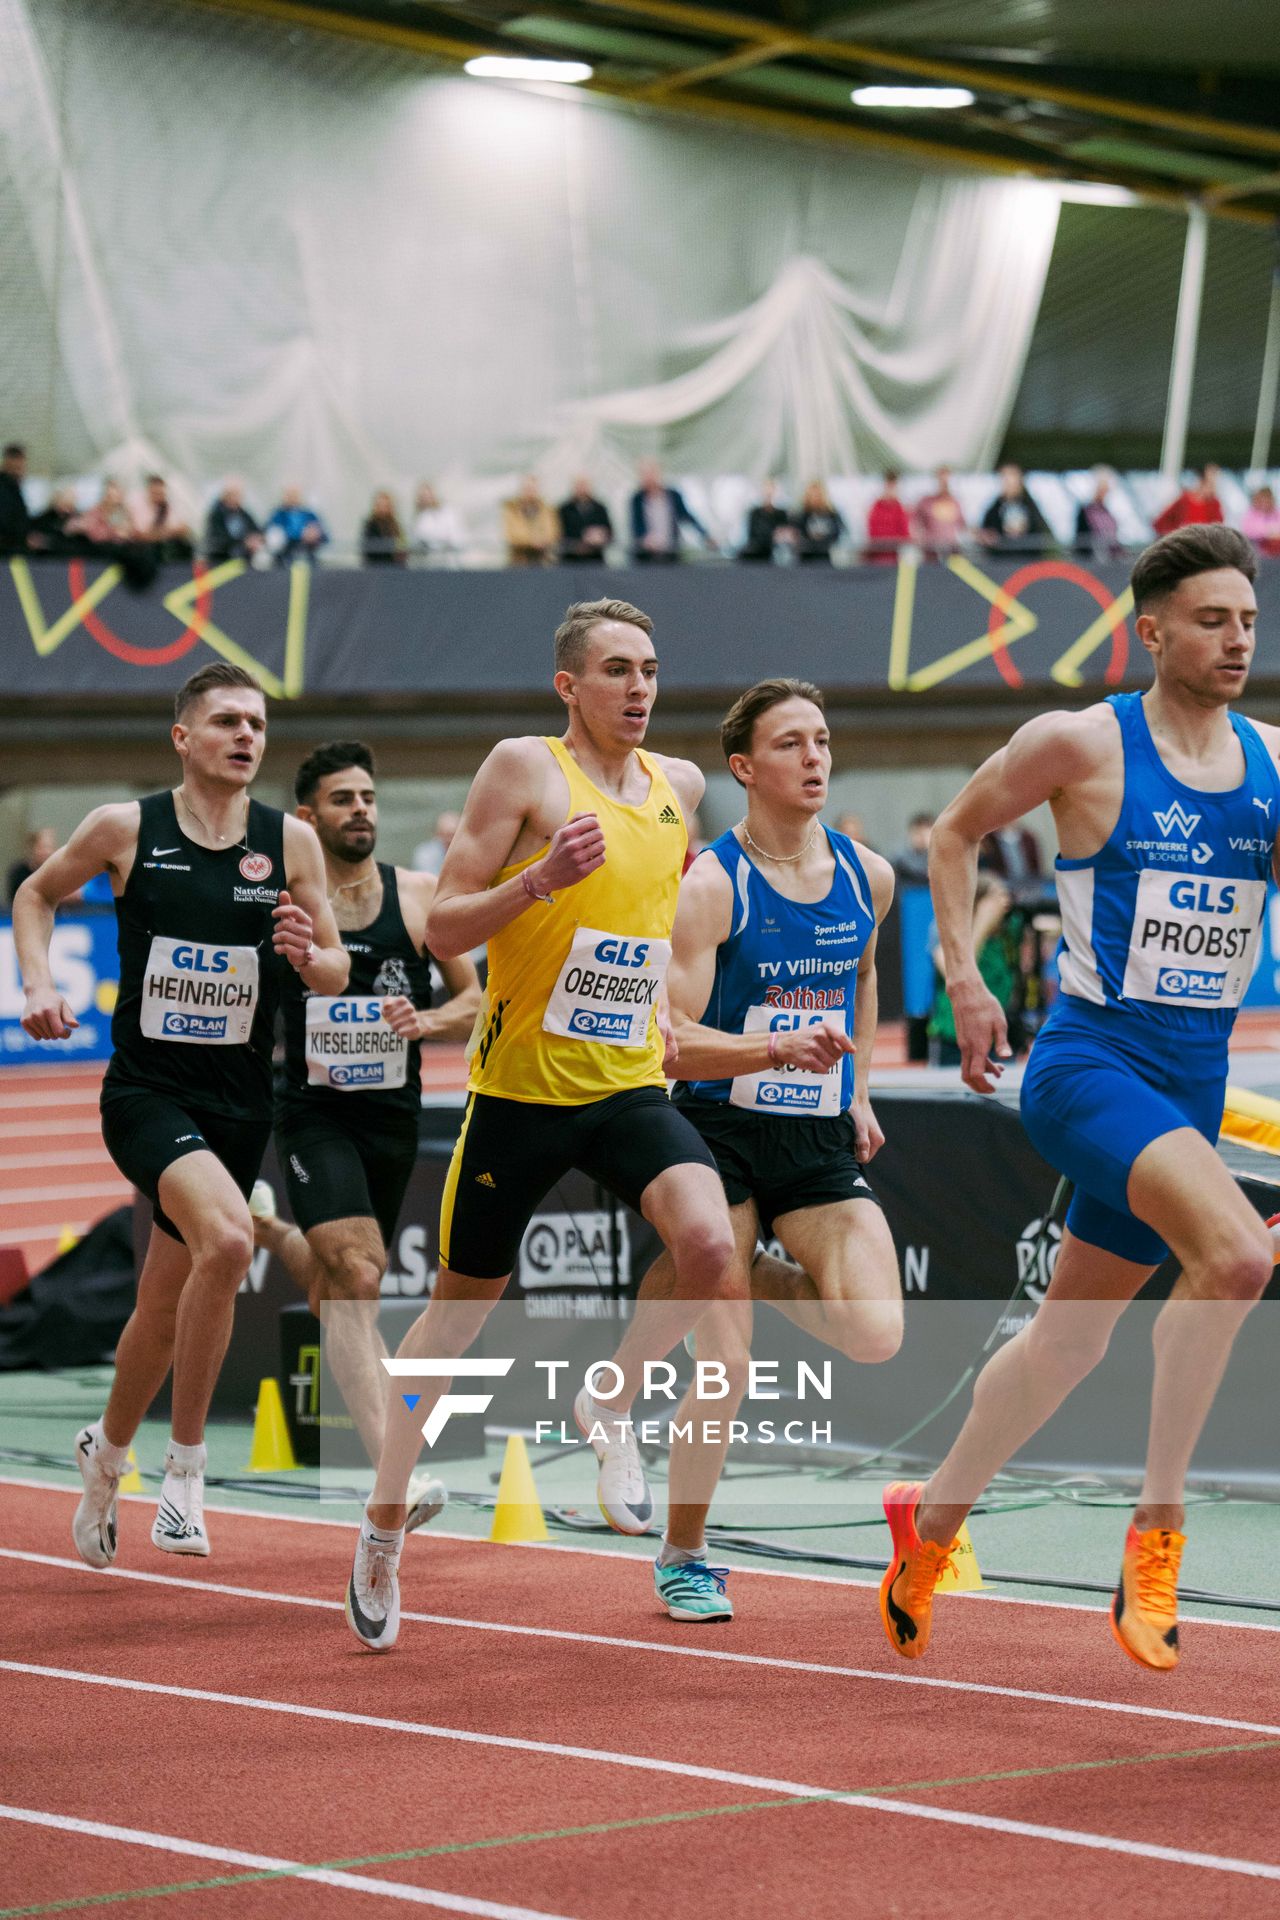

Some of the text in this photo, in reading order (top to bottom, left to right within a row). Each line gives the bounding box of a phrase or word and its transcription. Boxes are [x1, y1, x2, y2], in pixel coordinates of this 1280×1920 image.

[1126, 840, 1188, 853] STADTWERKE
[1149, 851, 1188, 862] BOCHUM
[814, 920, 857, 937] Sport-Weiß
[815, 934, 859, 946] Obereschach
[1141, 918, 1252, 958] PROBST
[758, 957, 860, 978] TV Villingen
[149, 974, 253, 1008] HEINRICH
[564, 967, 659, 1006] OBERBECK
[761, 984, 846, 1010] Rothaus
[189, 1018, 225, 1031] PLAN
[597, 1016, 630, 1032] PLAN
[310, 1031, 404, 1056] KIESELBERGER
[352, 1065, 383, 1079] PLAN
[783, 1087, 820, 1101] PLAN
